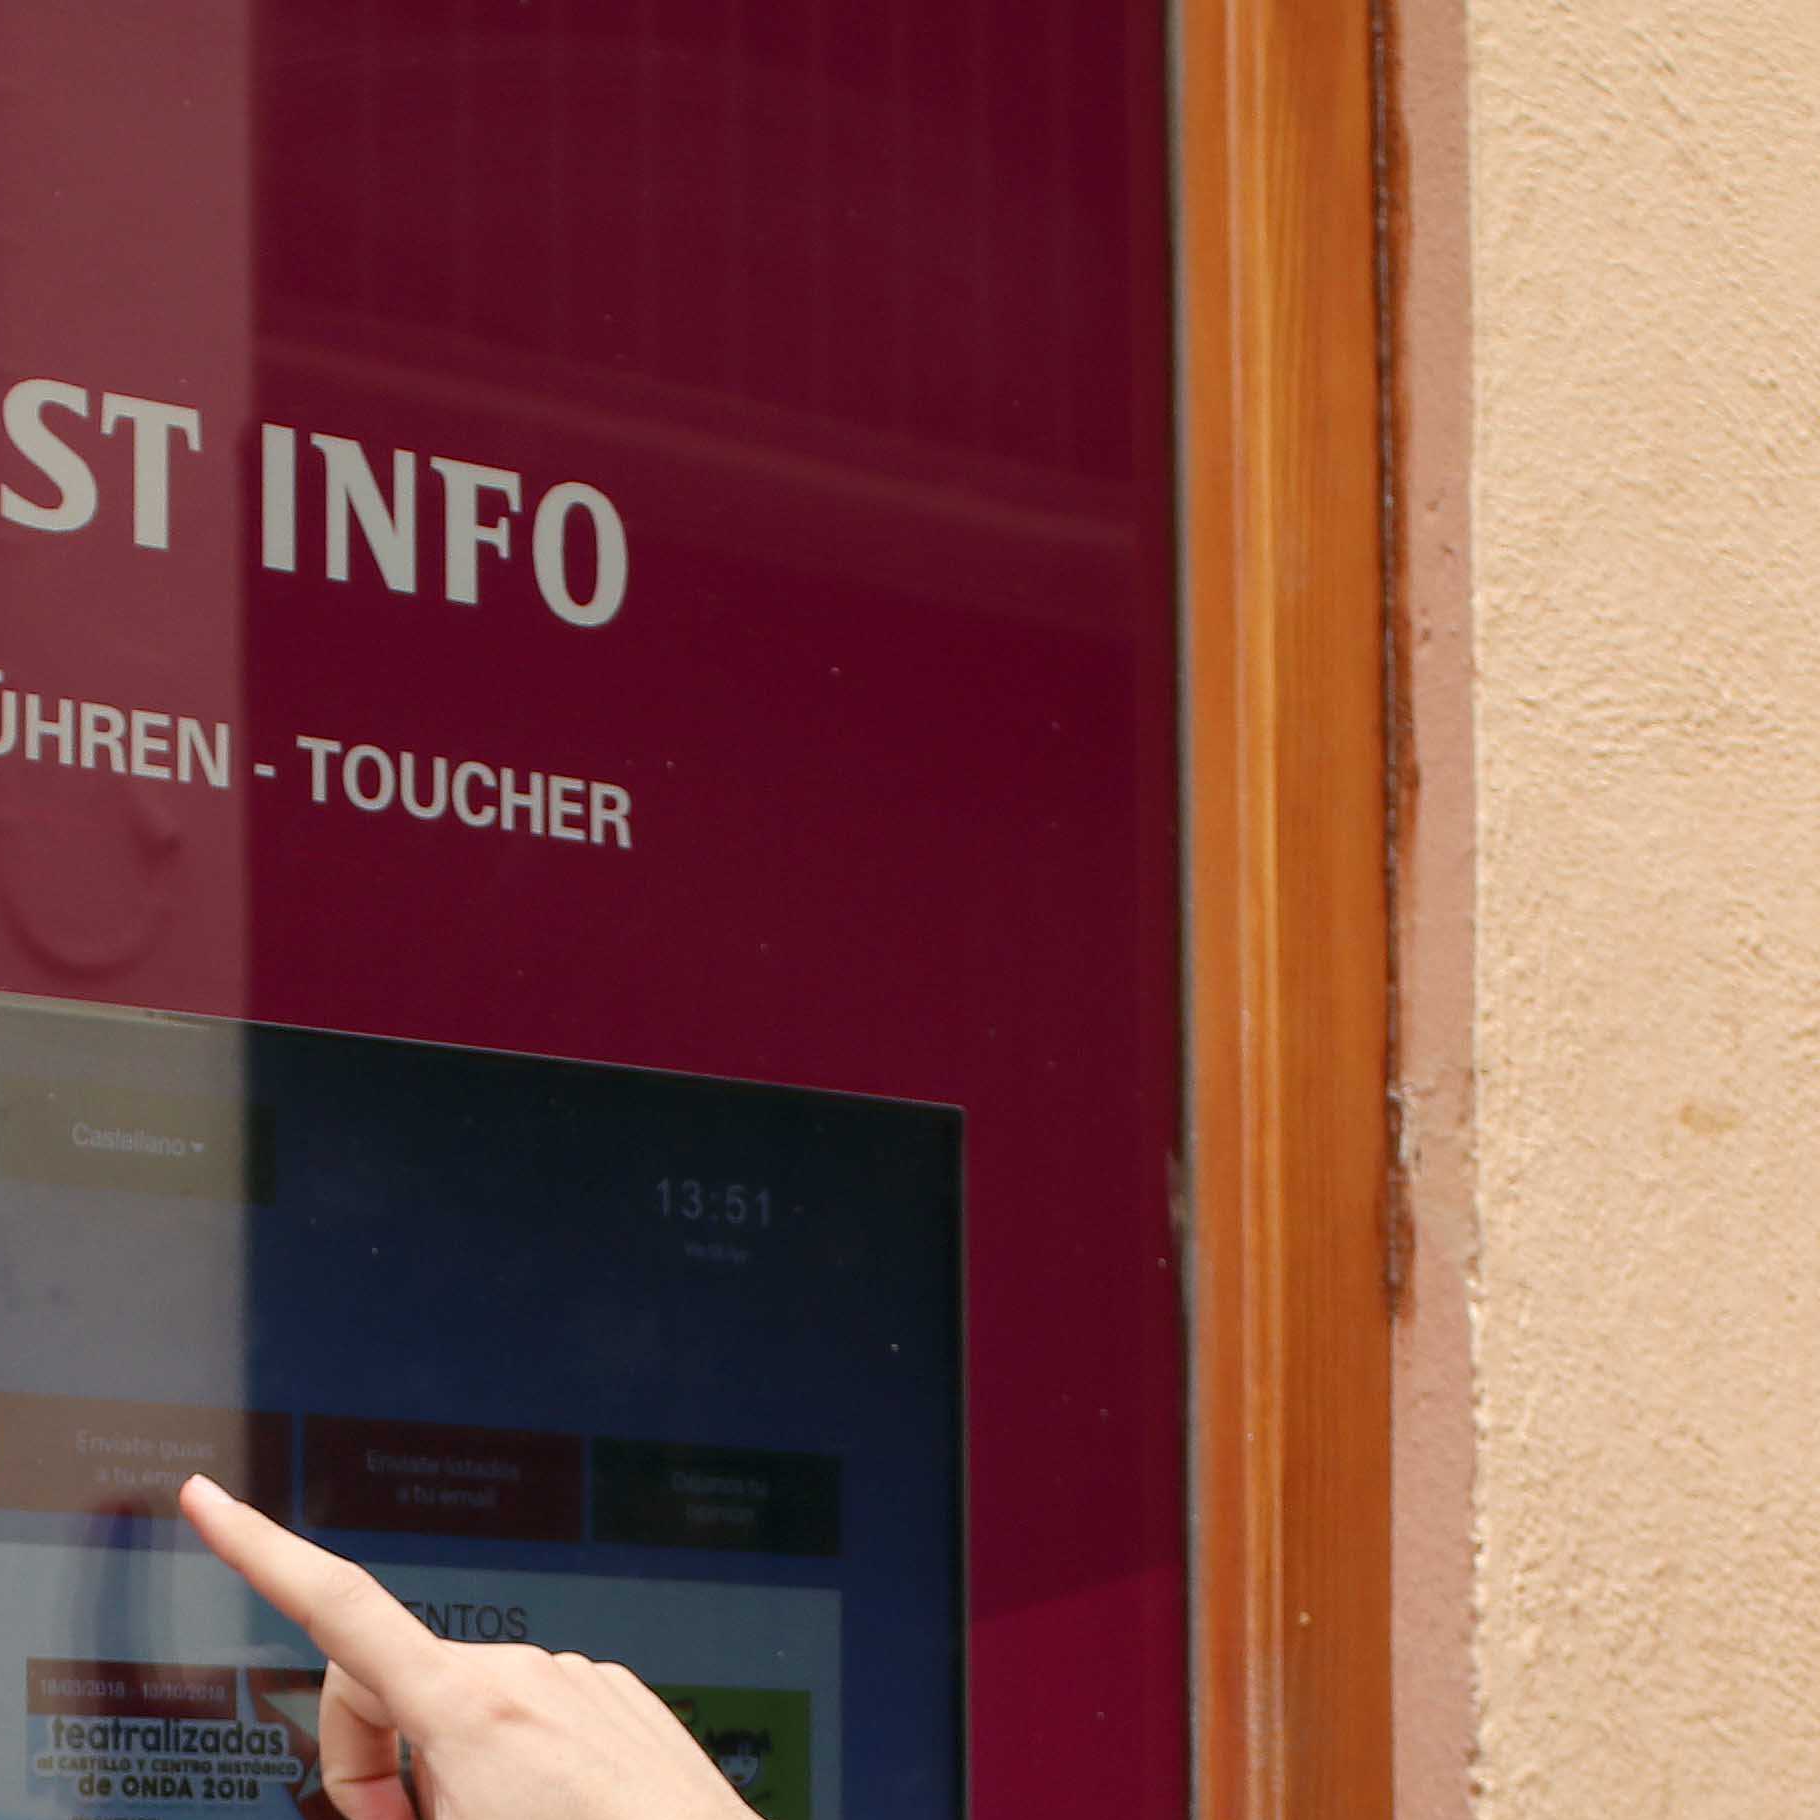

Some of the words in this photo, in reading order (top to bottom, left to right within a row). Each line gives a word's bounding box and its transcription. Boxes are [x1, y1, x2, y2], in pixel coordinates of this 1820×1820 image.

[261, 423, 629, 628] INFO
[295, 734, 633, 849] TOUCHER
[71, 1121, 186, 1156] Castellano
[655, 1177, 771, 1229] 13:51
[53, 1717, 284, 1757] teatralizadas
[77, 1775, 113, 1797] de
[120, 1776, 195, 1800] ONDA
[201, 1777, 261, 1801] 2018
